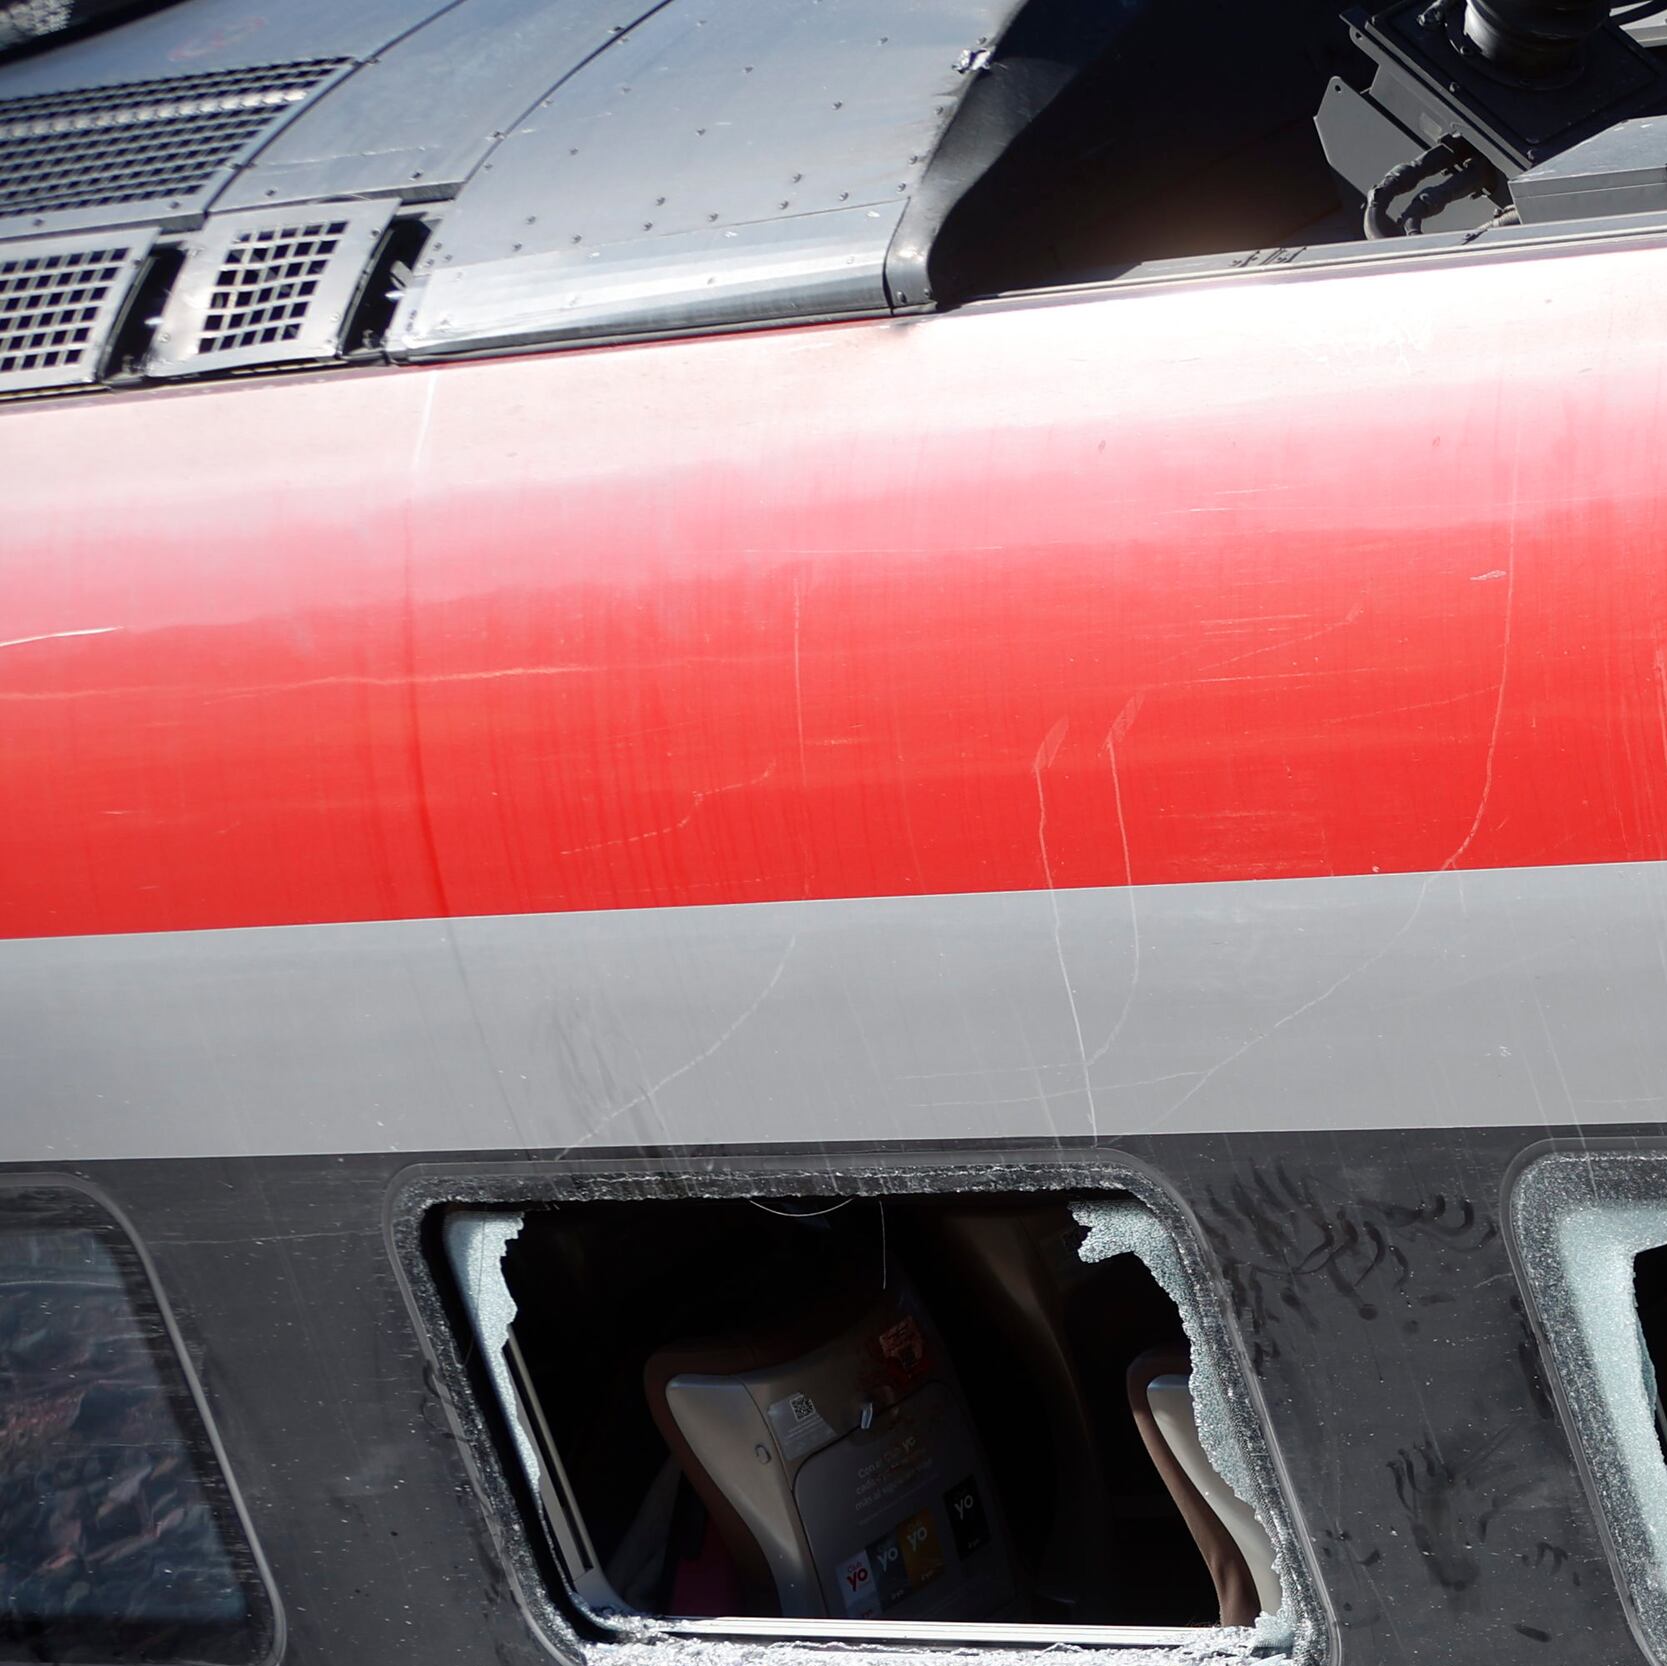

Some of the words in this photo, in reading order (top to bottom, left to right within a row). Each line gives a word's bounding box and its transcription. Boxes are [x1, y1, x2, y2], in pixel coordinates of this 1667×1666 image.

[902, 1436, 916, 1452] yo
[954, 1495, 974, 1521] yo
[907, 1526, 928, 1552] yo
[877, 1547, 898, 1573] yo
[847, 1568, 868, 1592] yo
